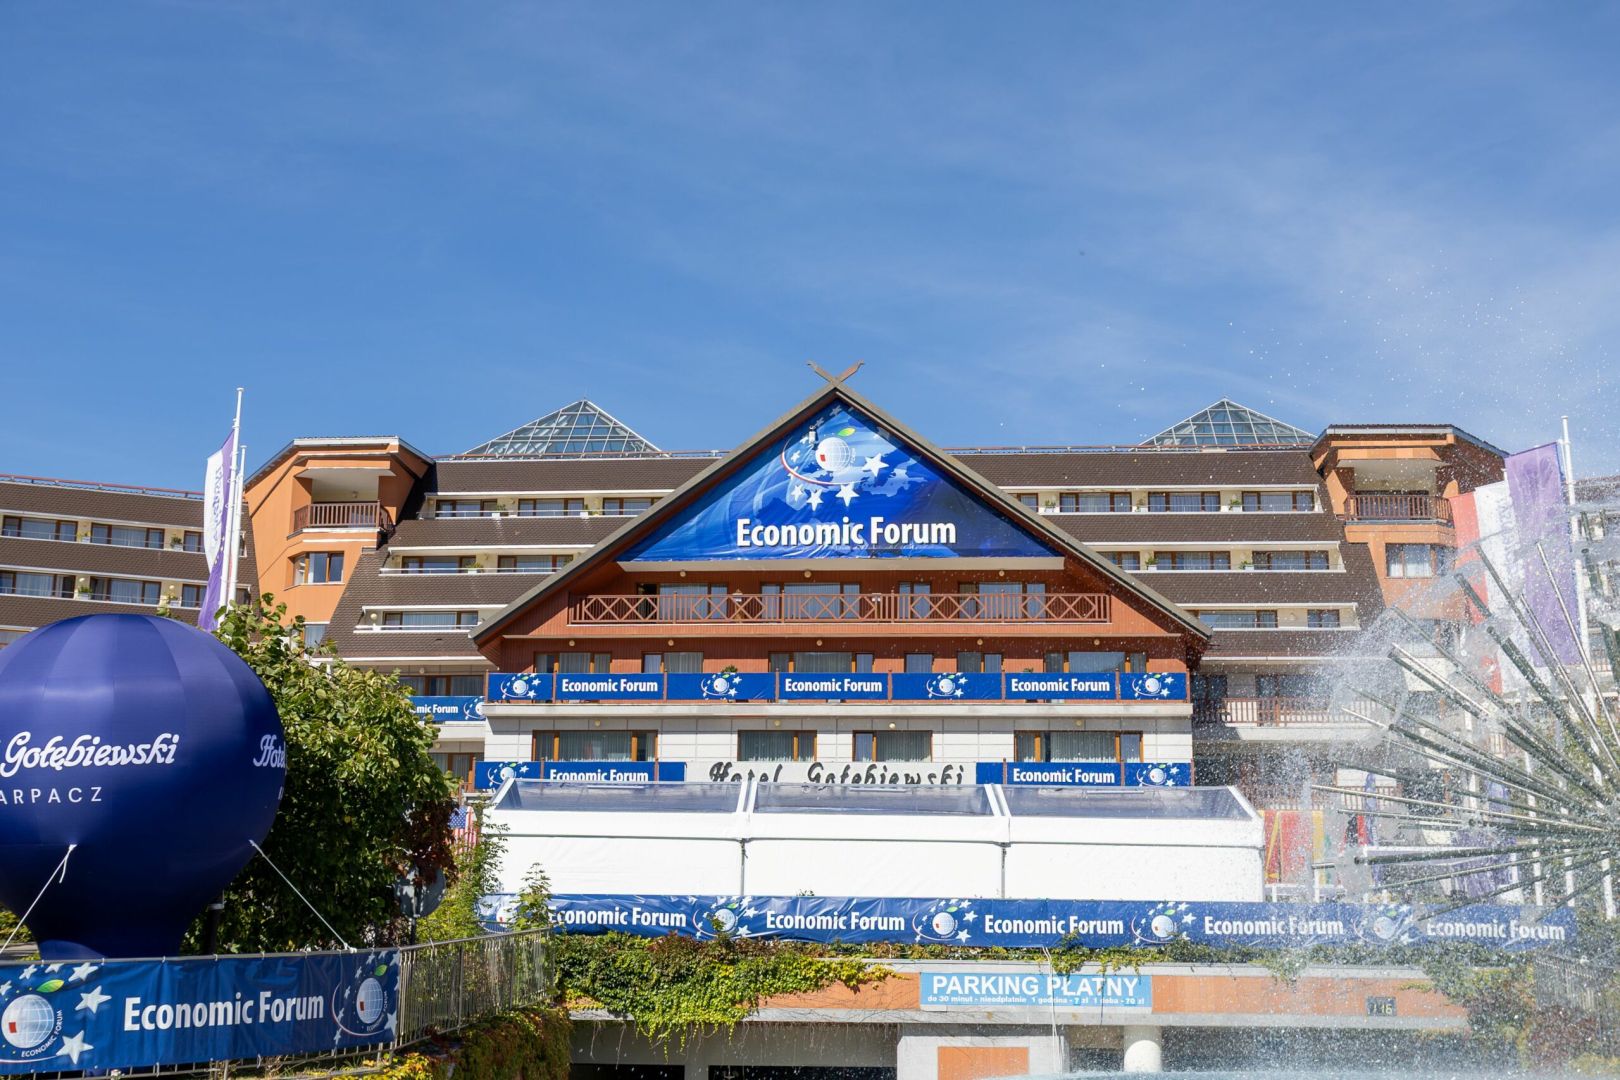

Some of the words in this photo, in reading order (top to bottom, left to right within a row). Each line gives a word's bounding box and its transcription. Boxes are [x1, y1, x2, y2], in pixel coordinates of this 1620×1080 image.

[737, 516, 864, 547] Economic
[871, 517, 957, 546] Forum
[562, 678, 618, 692] Economic
[621, 679, 658, 692] Forum
[785, 678, 842, 692] Economic
[844, 679, 883, 692] Forum
[1011, 678, 1069, 692] Economic
[1071, 679, 1110, 692] Forum
[432, 704, 459, 714] Forum
[0, 731, 180, 777] Gołębiewski
[550, 768, 607, 782] Economic
[609, 769, 649, 782] Forum
[1013, 767, 1074, 783] Economic
[1075, 768, 1115, 784] Forum
[632, 907, 687, 927] Forum
[766, 911, 846, 930] Economic
[851, 912, 905, 931] Forum
[984, 914, 1065, 934] Economic
[1069, 916, 1124, 935] Forum
[1204, 916, 1285, 935] Economic
[1288, 916, 1344, 936] Forum
[932, 975, 1039, 995] PARKING
[1047, 976, 1139, 997] PŁATNY
[124, 992, 253, 1032] Economic
[259, 990, 324, 1024] Forum
[21, 1034, 57, 1058] ECONOMIC
[54, 1009, 63, 1035] FORUM
